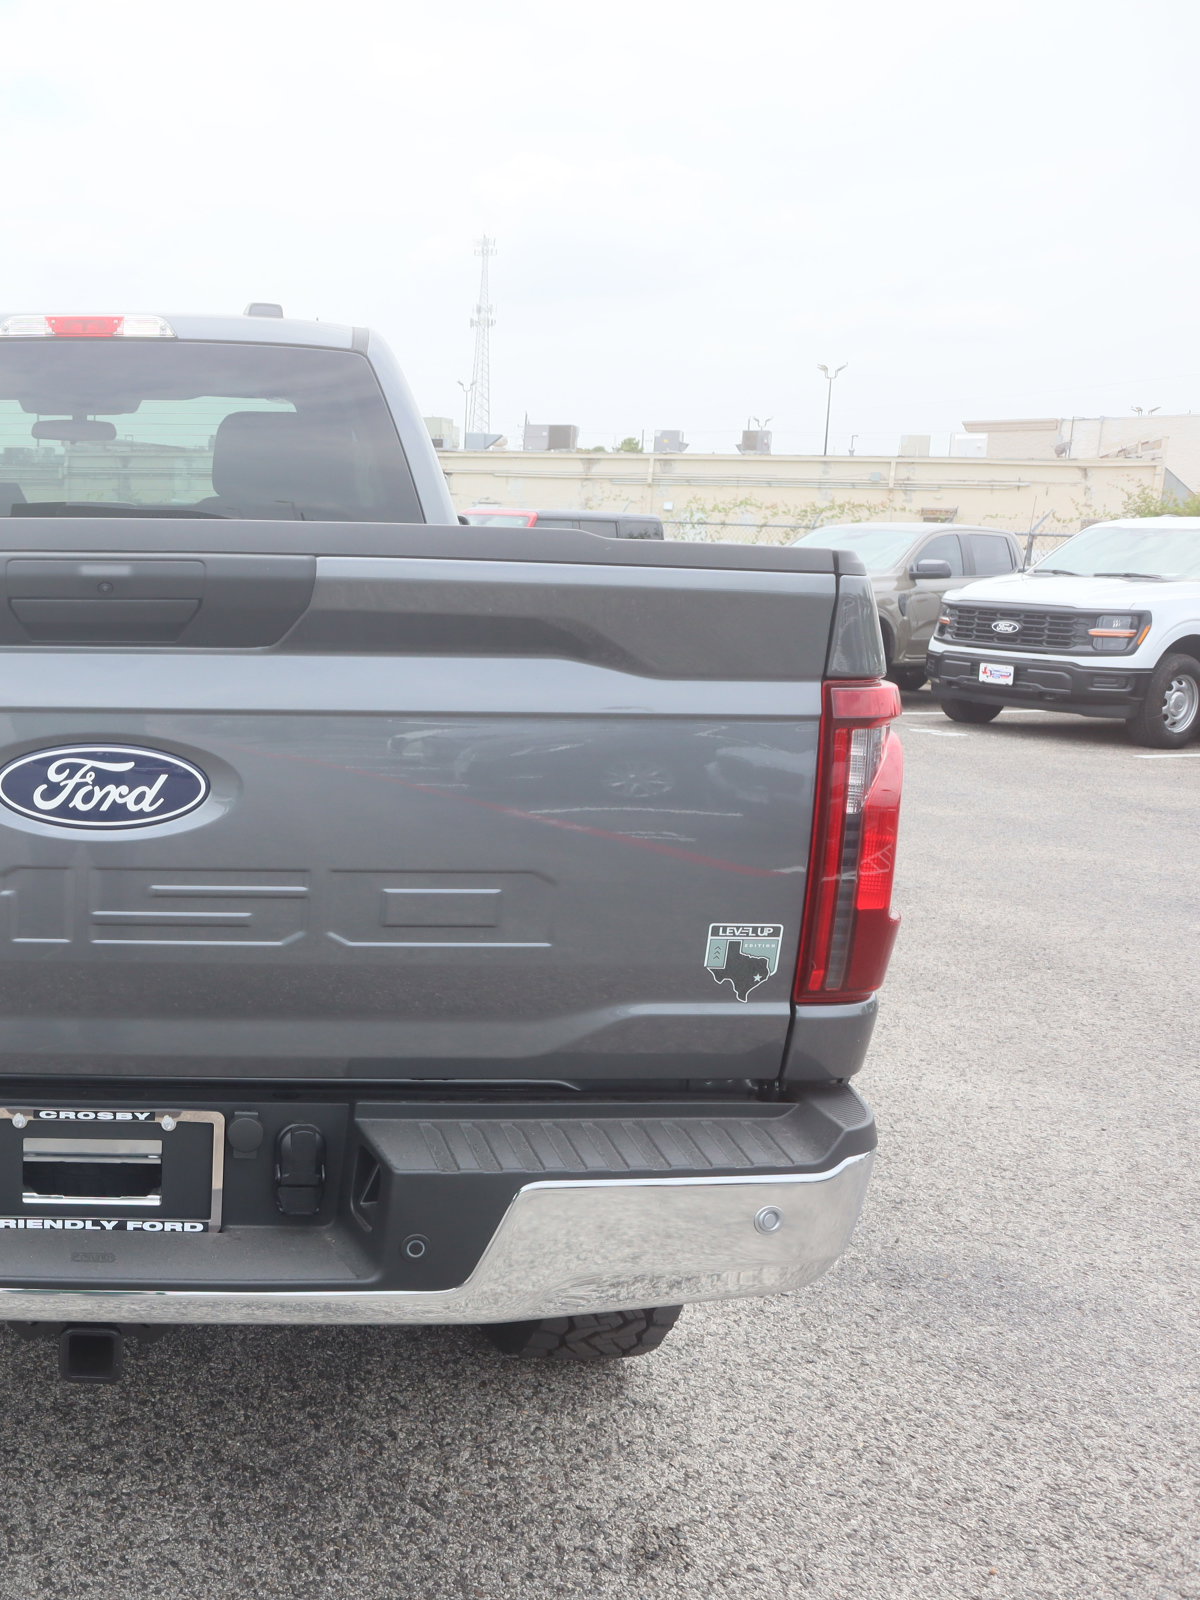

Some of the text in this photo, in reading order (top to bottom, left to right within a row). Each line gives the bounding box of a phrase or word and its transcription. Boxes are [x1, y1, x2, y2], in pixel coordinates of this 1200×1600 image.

[33, 757, 169, 812] Ford
[719, 926, 774, 936] LEVEL UP
[38, 1110, 151, 1121] CROSBY
[126, 1221, 205, 1232] FORD
